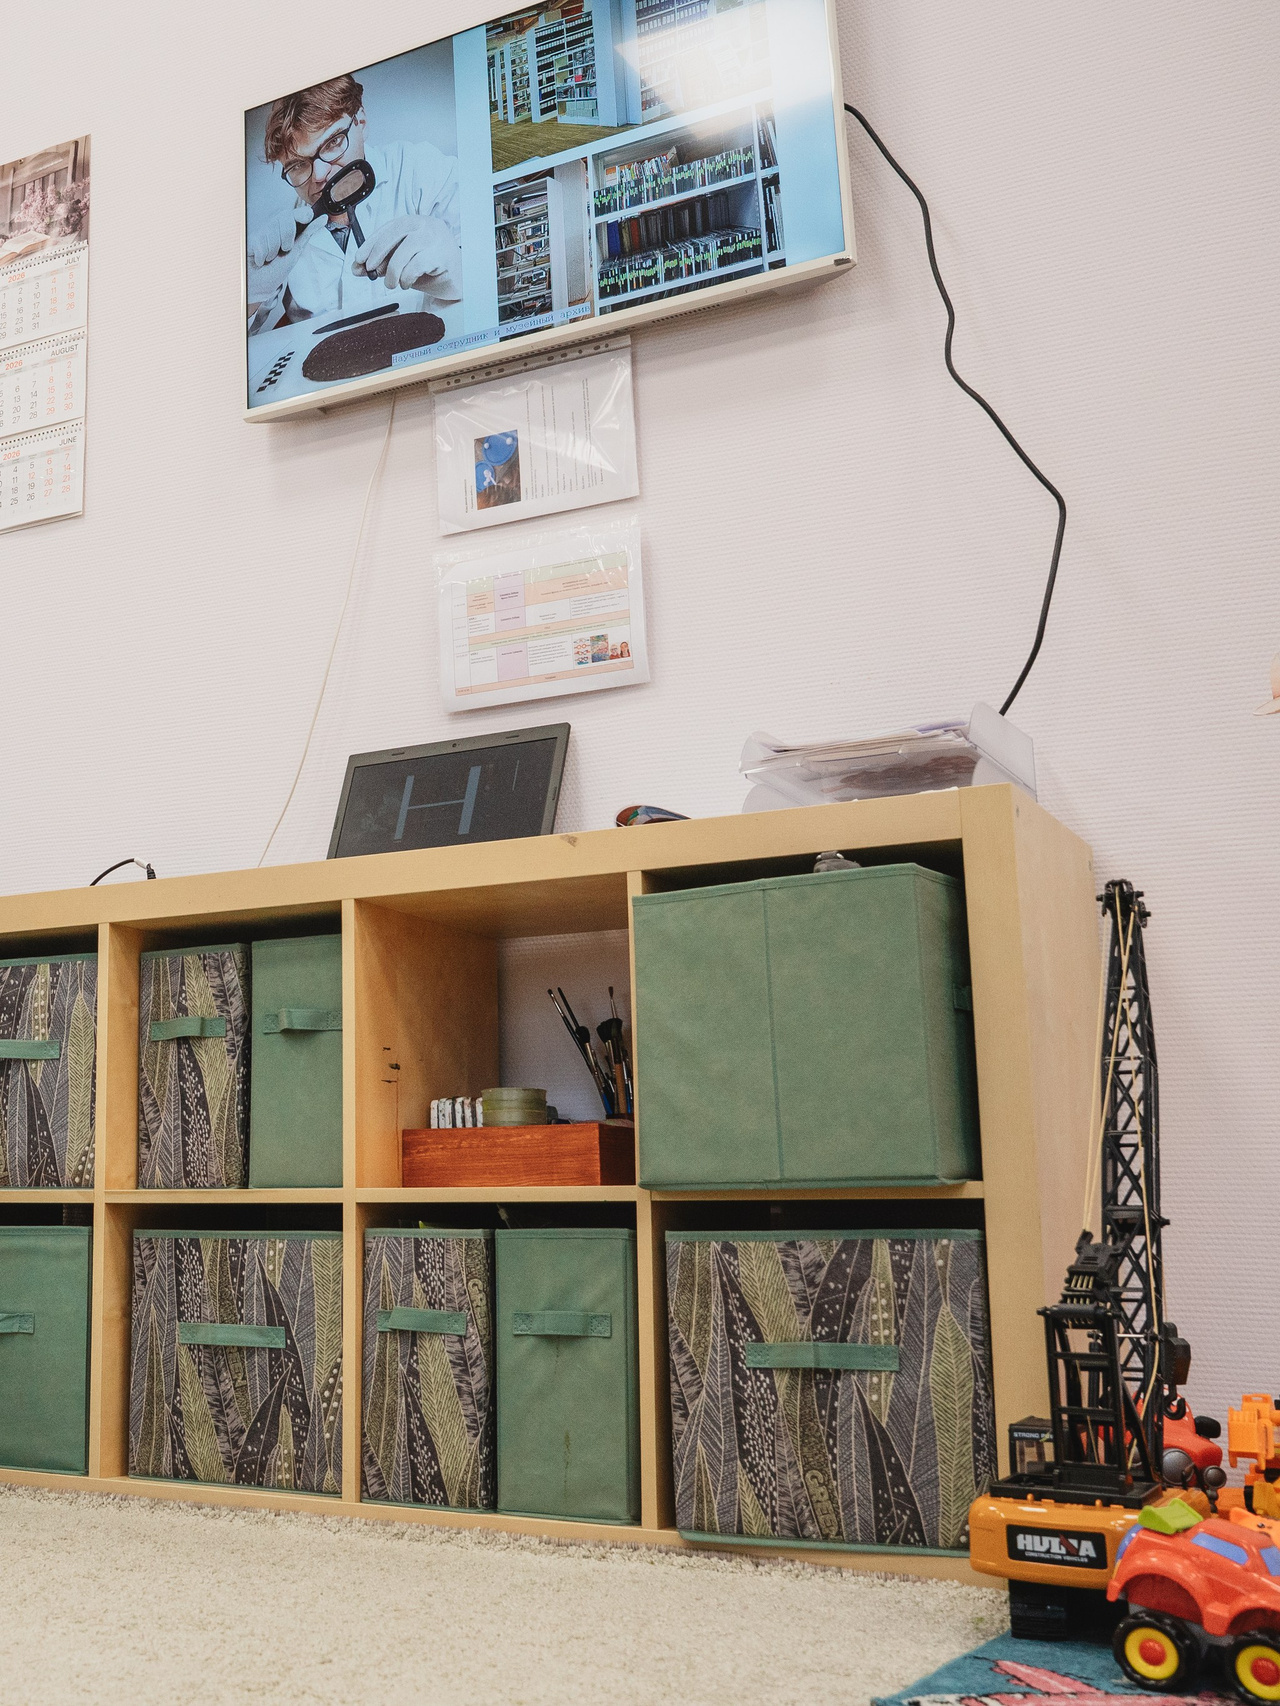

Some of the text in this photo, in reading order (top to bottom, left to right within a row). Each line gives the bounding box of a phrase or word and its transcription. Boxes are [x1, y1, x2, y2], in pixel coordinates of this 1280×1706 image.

[64, 255, 81, 266] JULY
[7, 272, 26, 283] 2026
[18, 287, 23, 295] 2
[35, 282, 40, 290] 3
[69, 272, 74, 280] 5
[0, 311, 7, 319] 15
[16, 306, 24, 314] 16
[33, 301, 40, 309] 17
[50, 296, 58, 305] 18
[67, 291, 75, 299] 19
[1, 302, 6, 310] 8
[17, 297, 23, 305] 9
[33, 291, 41, 299] 10
[67, 281, 75, 289] 12
[0, 321, 7, 330] 22
[15, 316, 24, 325] 23
[32, 311, 40, 320] 24
[49, 307, 58, 315] 25
[66, 302, 75, 310] 26
[14, 326, 23, 335] 30
[32, 322, 39, 330] 31
[392, 347, 432, 364] Научный
[436, 332, 489, 352] сотрудник
[506, 314, 554, 334] музейный
[559, 304, 590, 322] архив
[51, 344, 79, 357] AUGUST
[5, 360, 23, 371] 2026
[67, 360, 72, 369] 2
[0, 390, 4, 398] 5
[15, 385, 20, 393] 6
[32, 380, 37, 388] 7
[49, 376, 54, 384] 8
[66, 371, 72, 379] 9
[14, 395, 21, 403] 13
[30, 390, 38, 398] 14
[47, 385, 56, 394] 15
[65, 381, 73, 389] 16
[12, 405, 21, 414] 20
[30, 401, 37, 409] 21
[46, 396, 55, 405] 22
[64, 391, 73, 401] 23
[12, 415, 21, 424] 27
[29, 411, 38, 420] 28
[46, 407, 55, 415] 29
[64, 402, 73, 411] 30
[59, 436, 77, 446] JUNE
[3, 450, 21, 461] 2026
[30, 461, 35, 469] 5
[47, 457, 53, 465] 6
[65, 452, 70, 461] 7
[11, 486, 18, 494] 18
[28, 482, 35, 490] 19
[44, 478, 53, 486] 20
[62, 474, 71, 483] 21
[12, 476, 18, 484] 11
[28, 471, 36, 480] 12
[45, 467, 53, 475] 13
[63, 463, 71, 471] 14
[10, 497, 19, 506] 25
[26, 492, 35, 501] 26
[44, 488, 53, 497] 27
[61, 485, 71, 493] 28
[1013, 1431, 1040, 1439] STRONG
[1016, 1533, 1097, 1558] HUINA
